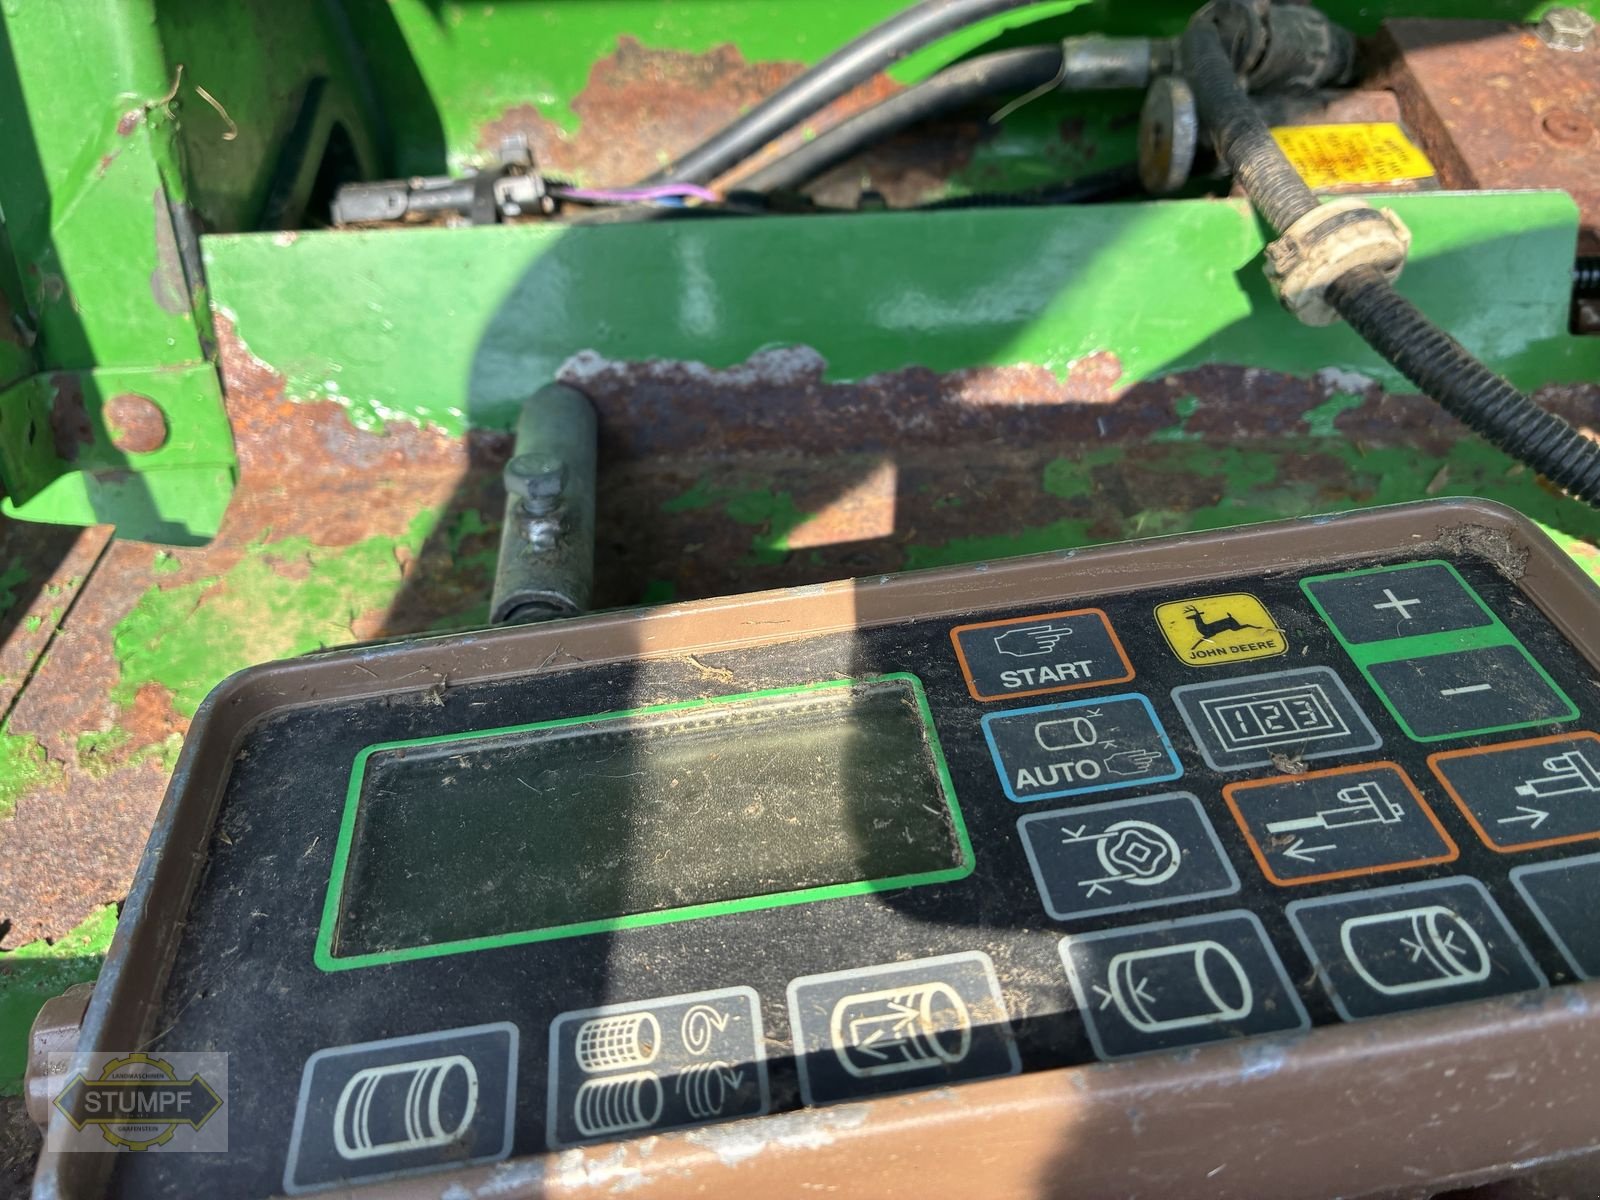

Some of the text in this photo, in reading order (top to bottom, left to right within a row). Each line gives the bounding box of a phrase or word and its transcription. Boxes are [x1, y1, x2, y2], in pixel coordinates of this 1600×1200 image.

[1189, 640, 1277, 661] JOHN DEERE
[1000, 660, 1093, 689] START
[1015, 759, 1101, 790] AUTO
